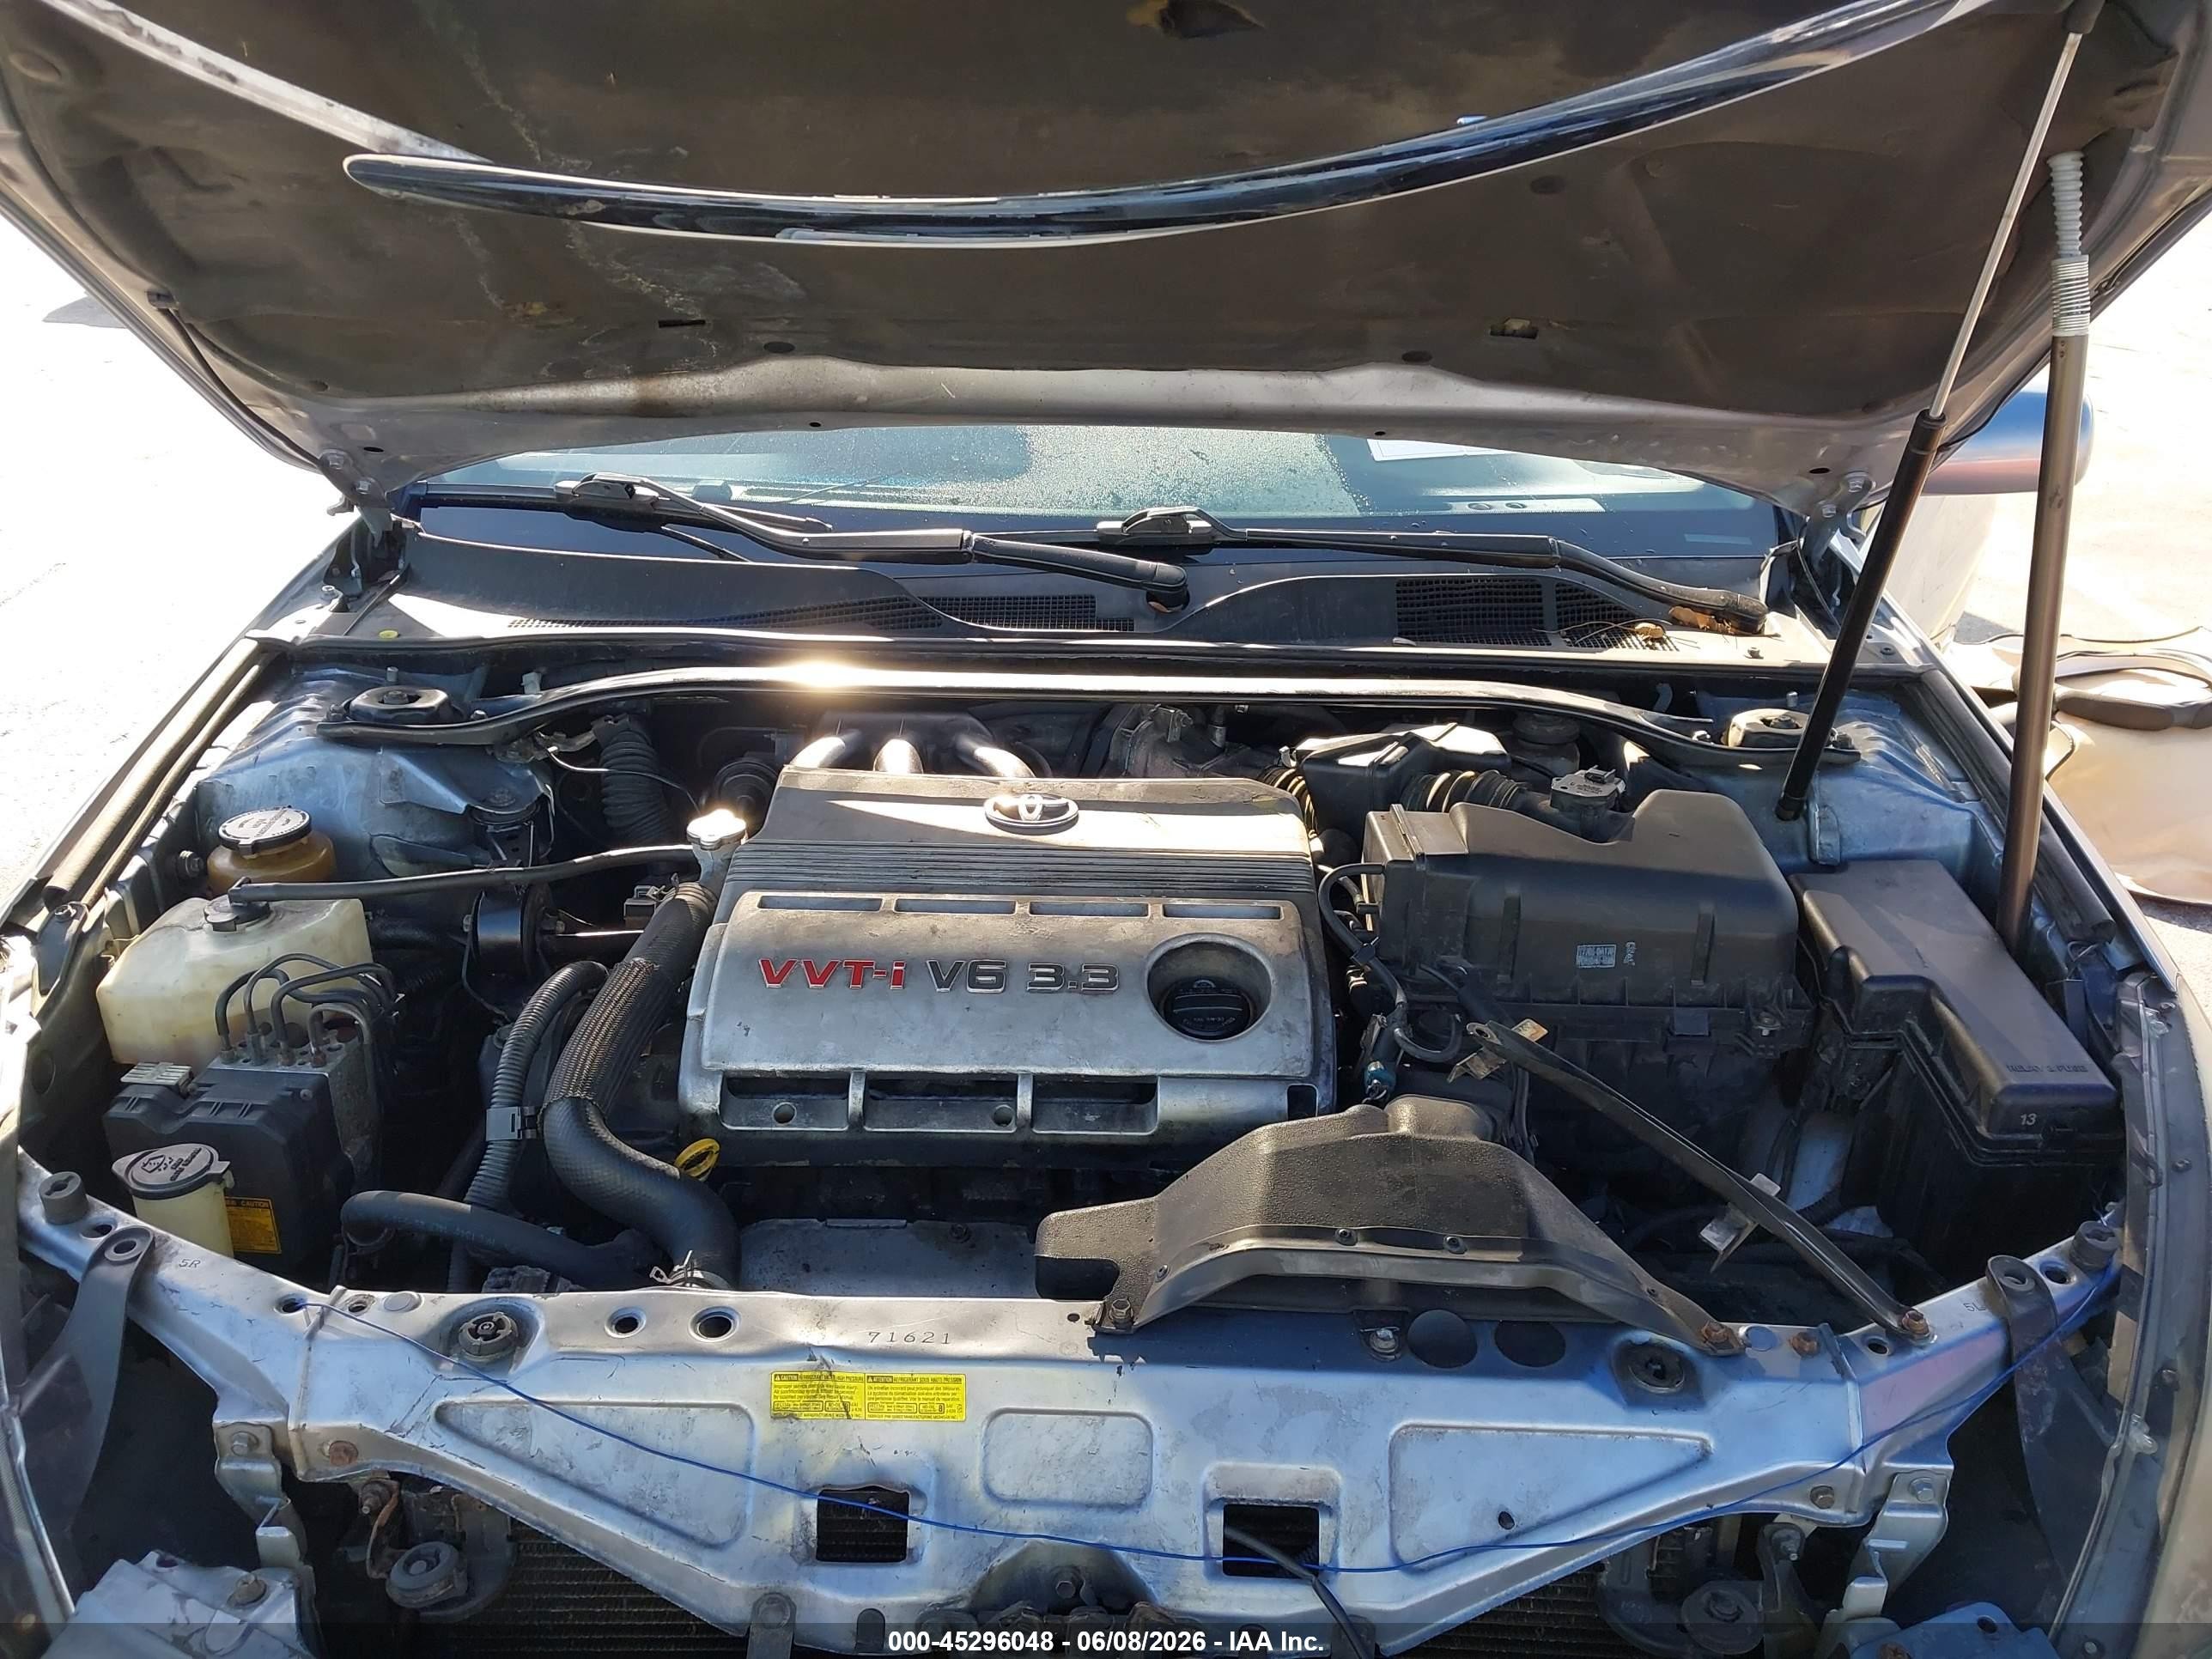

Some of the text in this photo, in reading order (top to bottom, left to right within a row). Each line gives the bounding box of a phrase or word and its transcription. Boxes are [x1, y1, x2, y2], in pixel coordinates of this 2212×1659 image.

[758, 958, 1120, 994] VVT-i V6 3.3
[2020, 1113, 2037, 1126] 13
[867, 1331, 951, 1345] 71621
